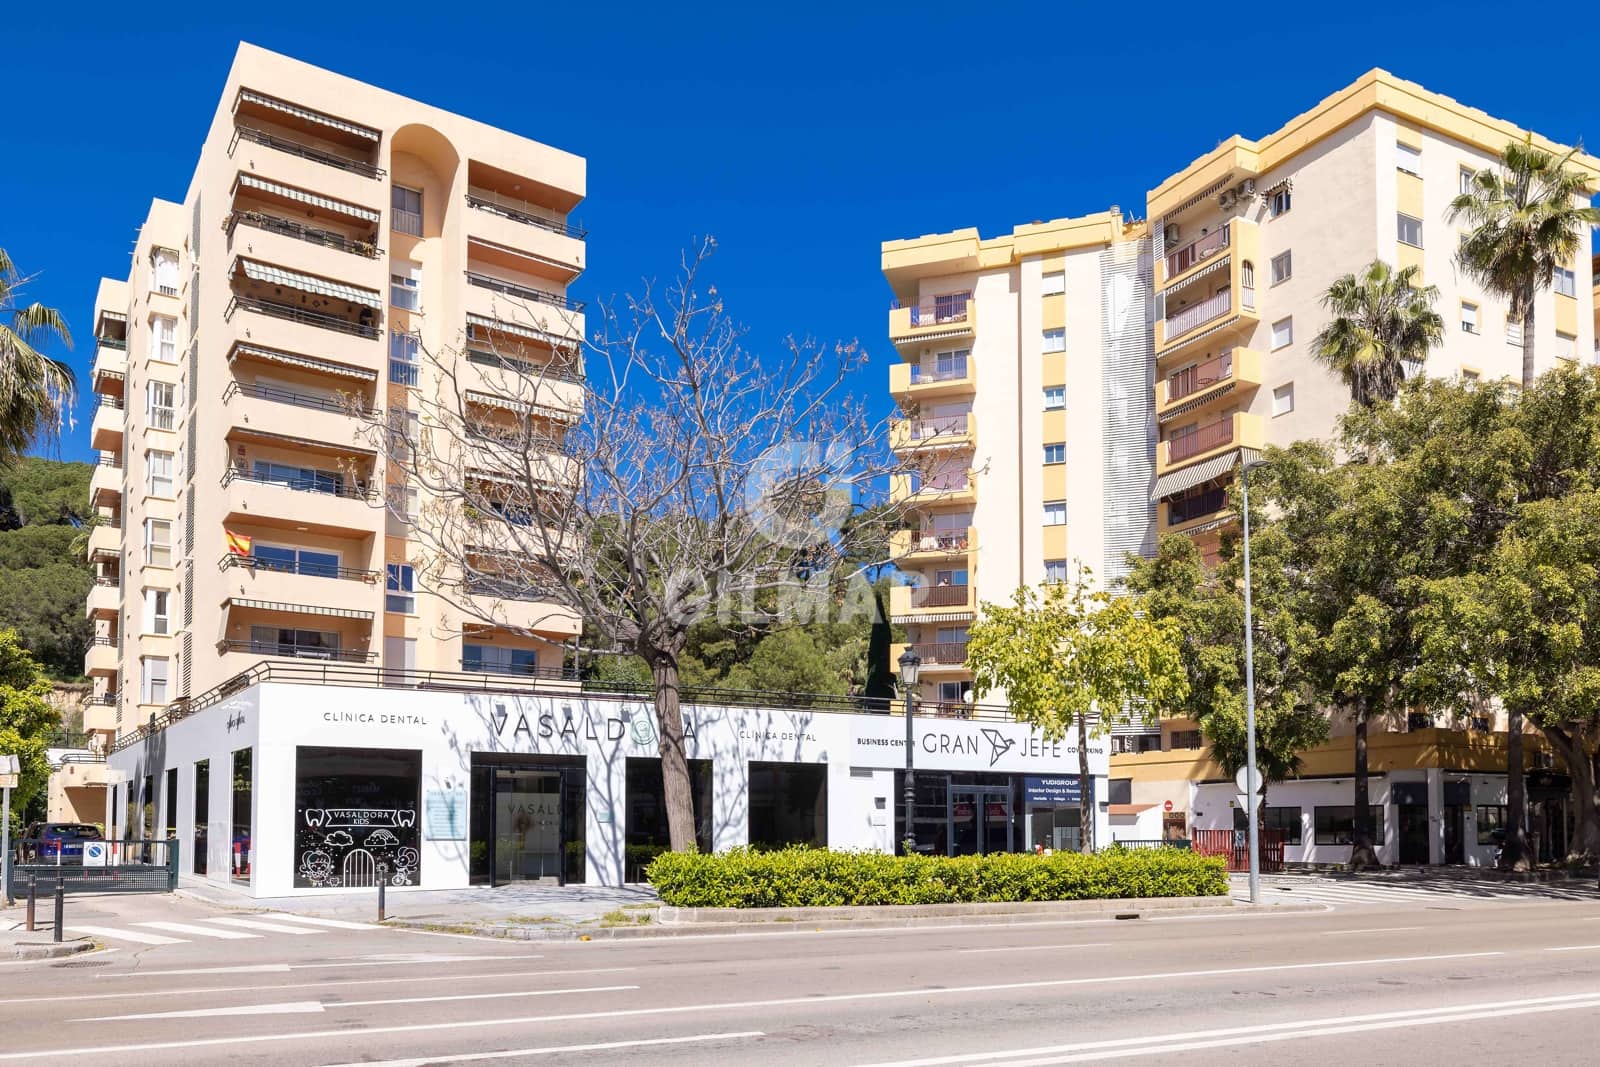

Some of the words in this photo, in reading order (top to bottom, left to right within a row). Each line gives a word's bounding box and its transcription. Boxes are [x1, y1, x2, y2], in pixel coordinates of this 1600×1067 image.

[323, 711, 375, 723] CLÍNICA
[380, 714, 428, 725] DENTAL
[781, 732, 817, 742] DENTAL
[857, 737, 889, 746] BUSINESS
[890, 739, 916, 748] CENTR
[922, 733, 978, 755] GRAN
[1020, 737, 1061, 758] JEFE
[333, 811, 389, 819] VASALDORA
